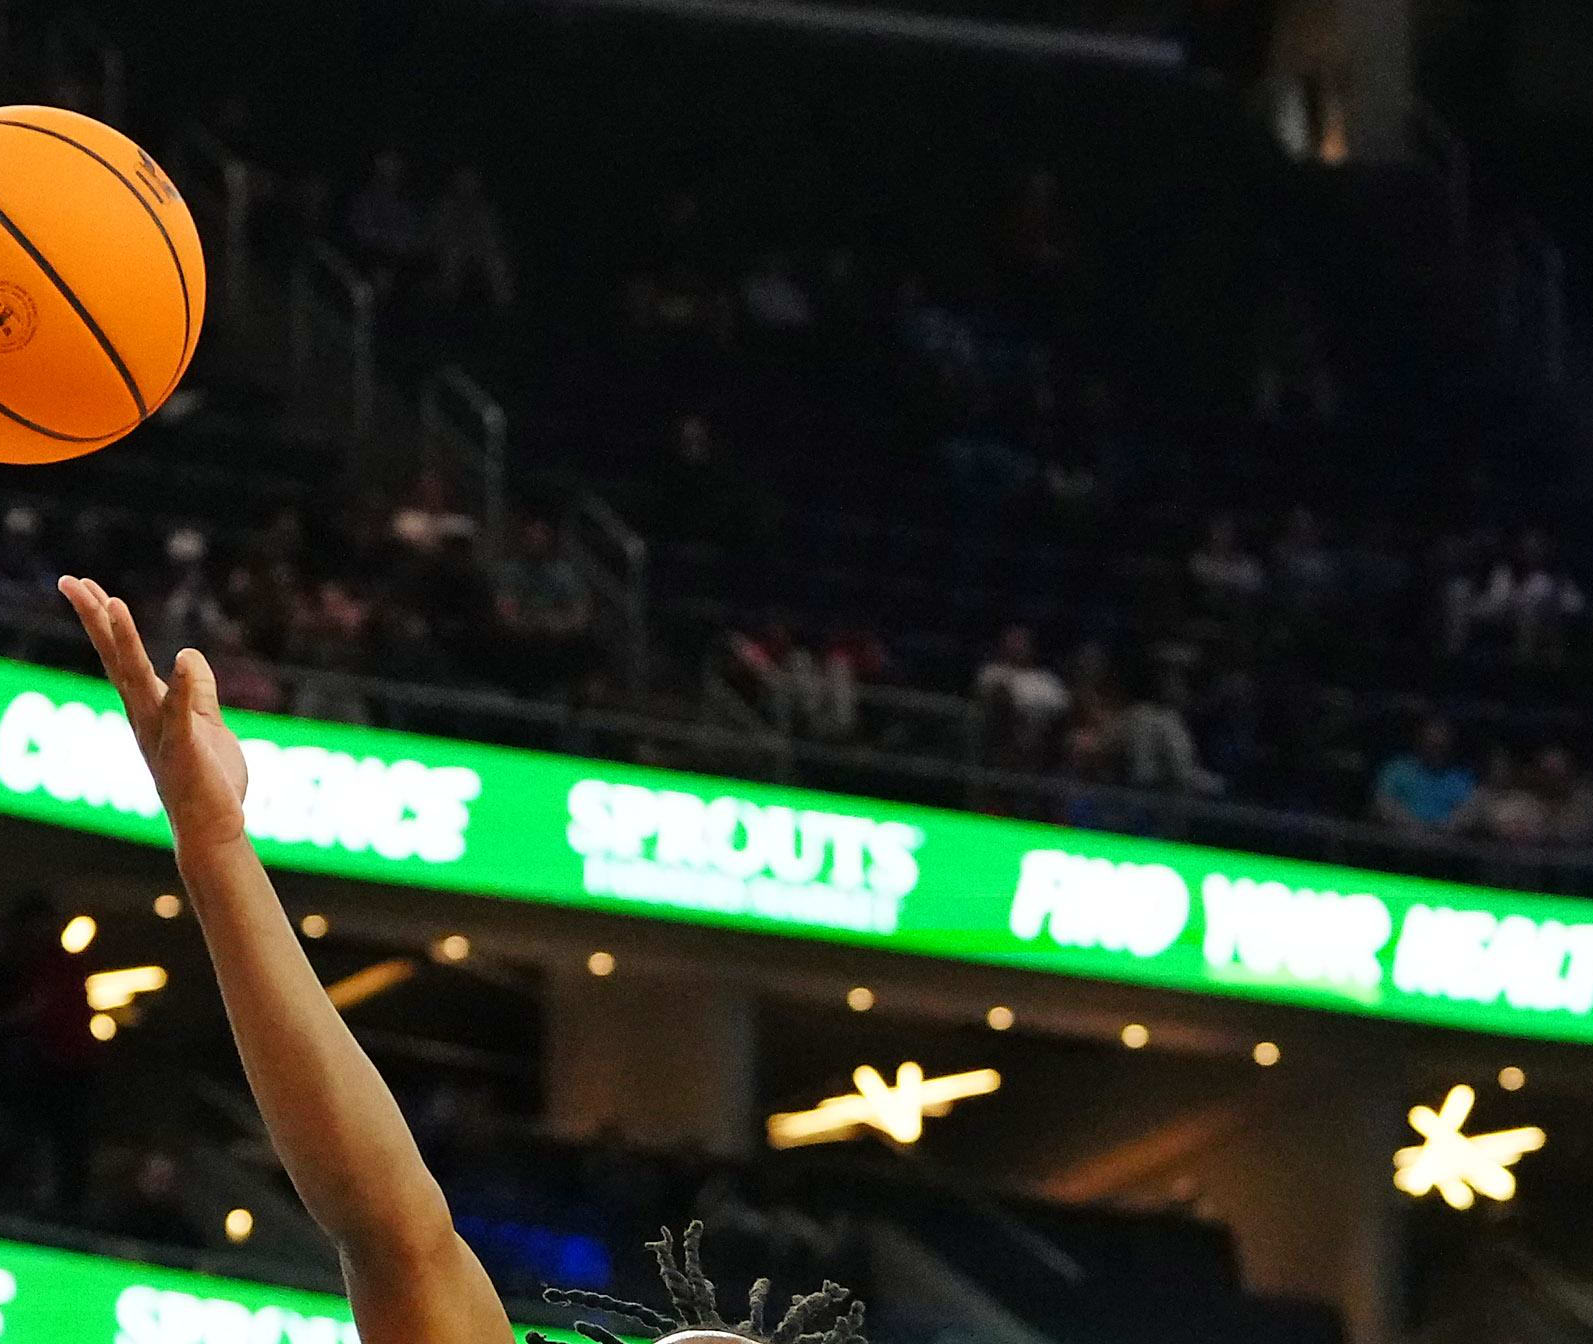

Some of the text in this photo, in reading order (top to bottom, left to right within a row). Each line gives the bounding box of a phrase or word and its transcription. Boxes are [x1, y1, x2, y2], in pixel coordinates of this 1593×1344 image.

[567, 779, 922, 896] SPROUTS
[1009, 849, 1191, 957] FIND
[1201, 873, 1393, 984] YOUR
